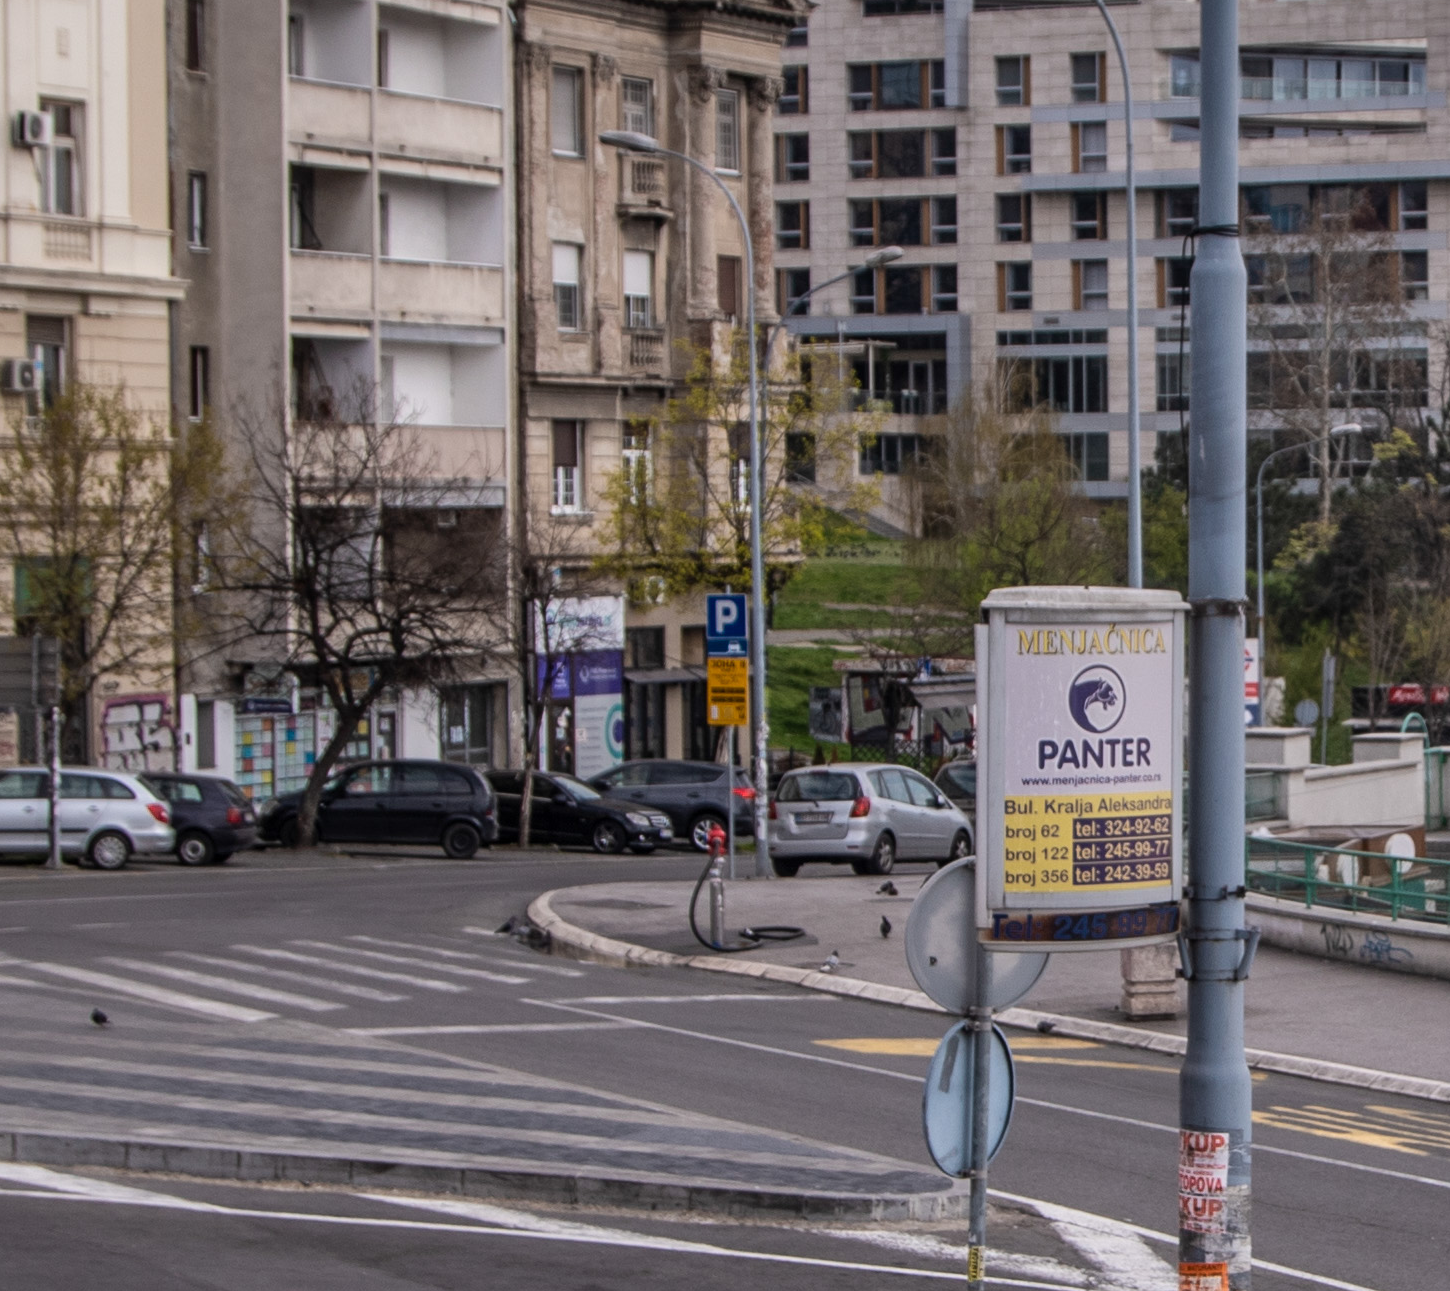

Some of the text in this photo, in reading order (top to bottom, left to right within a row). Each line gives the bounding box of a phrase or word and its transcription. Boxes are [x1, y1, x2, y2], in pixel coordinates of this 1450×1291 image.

[716, 600, 738, 633] P
[1017, 623, 1166, 655] MENJAČNICA
[1038, 738, 1151, 770] PANTER
[1021, 773, 1162, 788] www.menjacnica-panter.co.rs
[1005, 796, 1171, 817] Bul. Kralja Aleksandra
[1005, 817, 1169, 841] broj 62 tel: 324-92-62
[1005, 840, 1169, 864] broj 122 tel: 245-99-77
[1005, 863, 1169, 887] broj 356 tel: 242-39-59
[992, 913, 1041, 939] Tel:
[1053, 914, 1107, 939] 245
[1180, 1132, 1225, 1153] KUP
[1179, 1195, 1213, 1217] KUP
